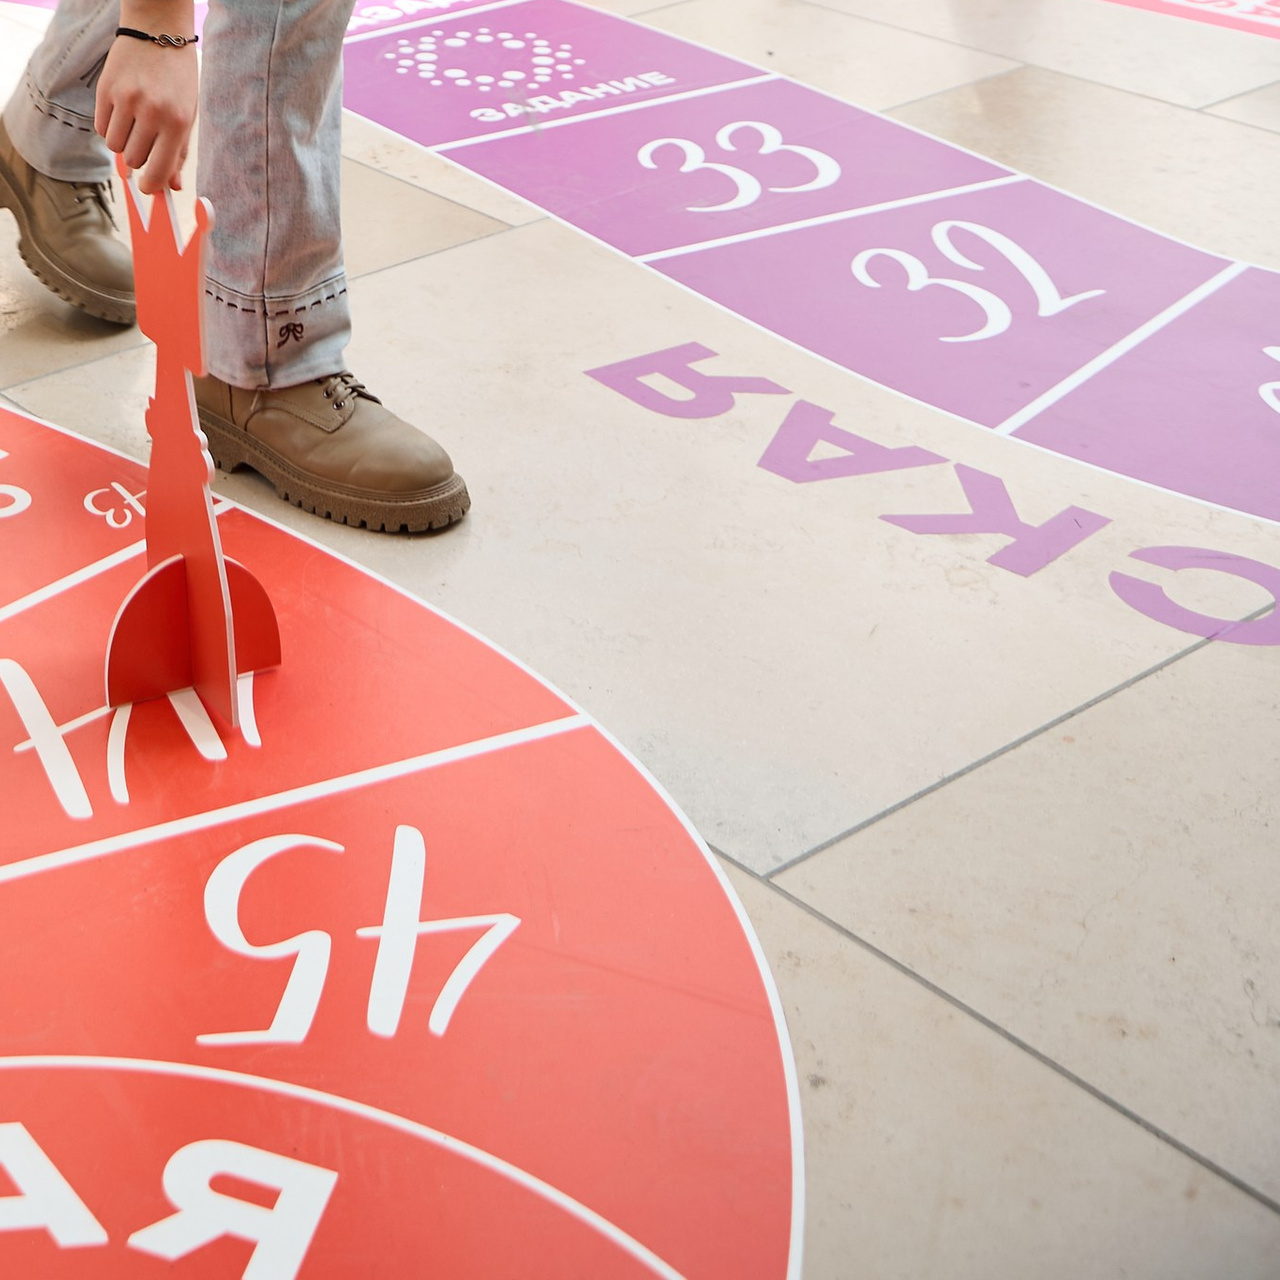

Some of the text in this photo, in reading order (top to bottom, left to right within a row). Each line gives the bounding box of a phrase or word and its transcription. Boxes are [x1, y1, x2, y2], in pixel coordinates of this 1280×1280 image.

[469, 70, 677, 125] ЗАДАНИЕ
[636, 120, 842, 213] 33
[850, 219, 1107, 343] 32
[195, 824, 522, 1047] 45
